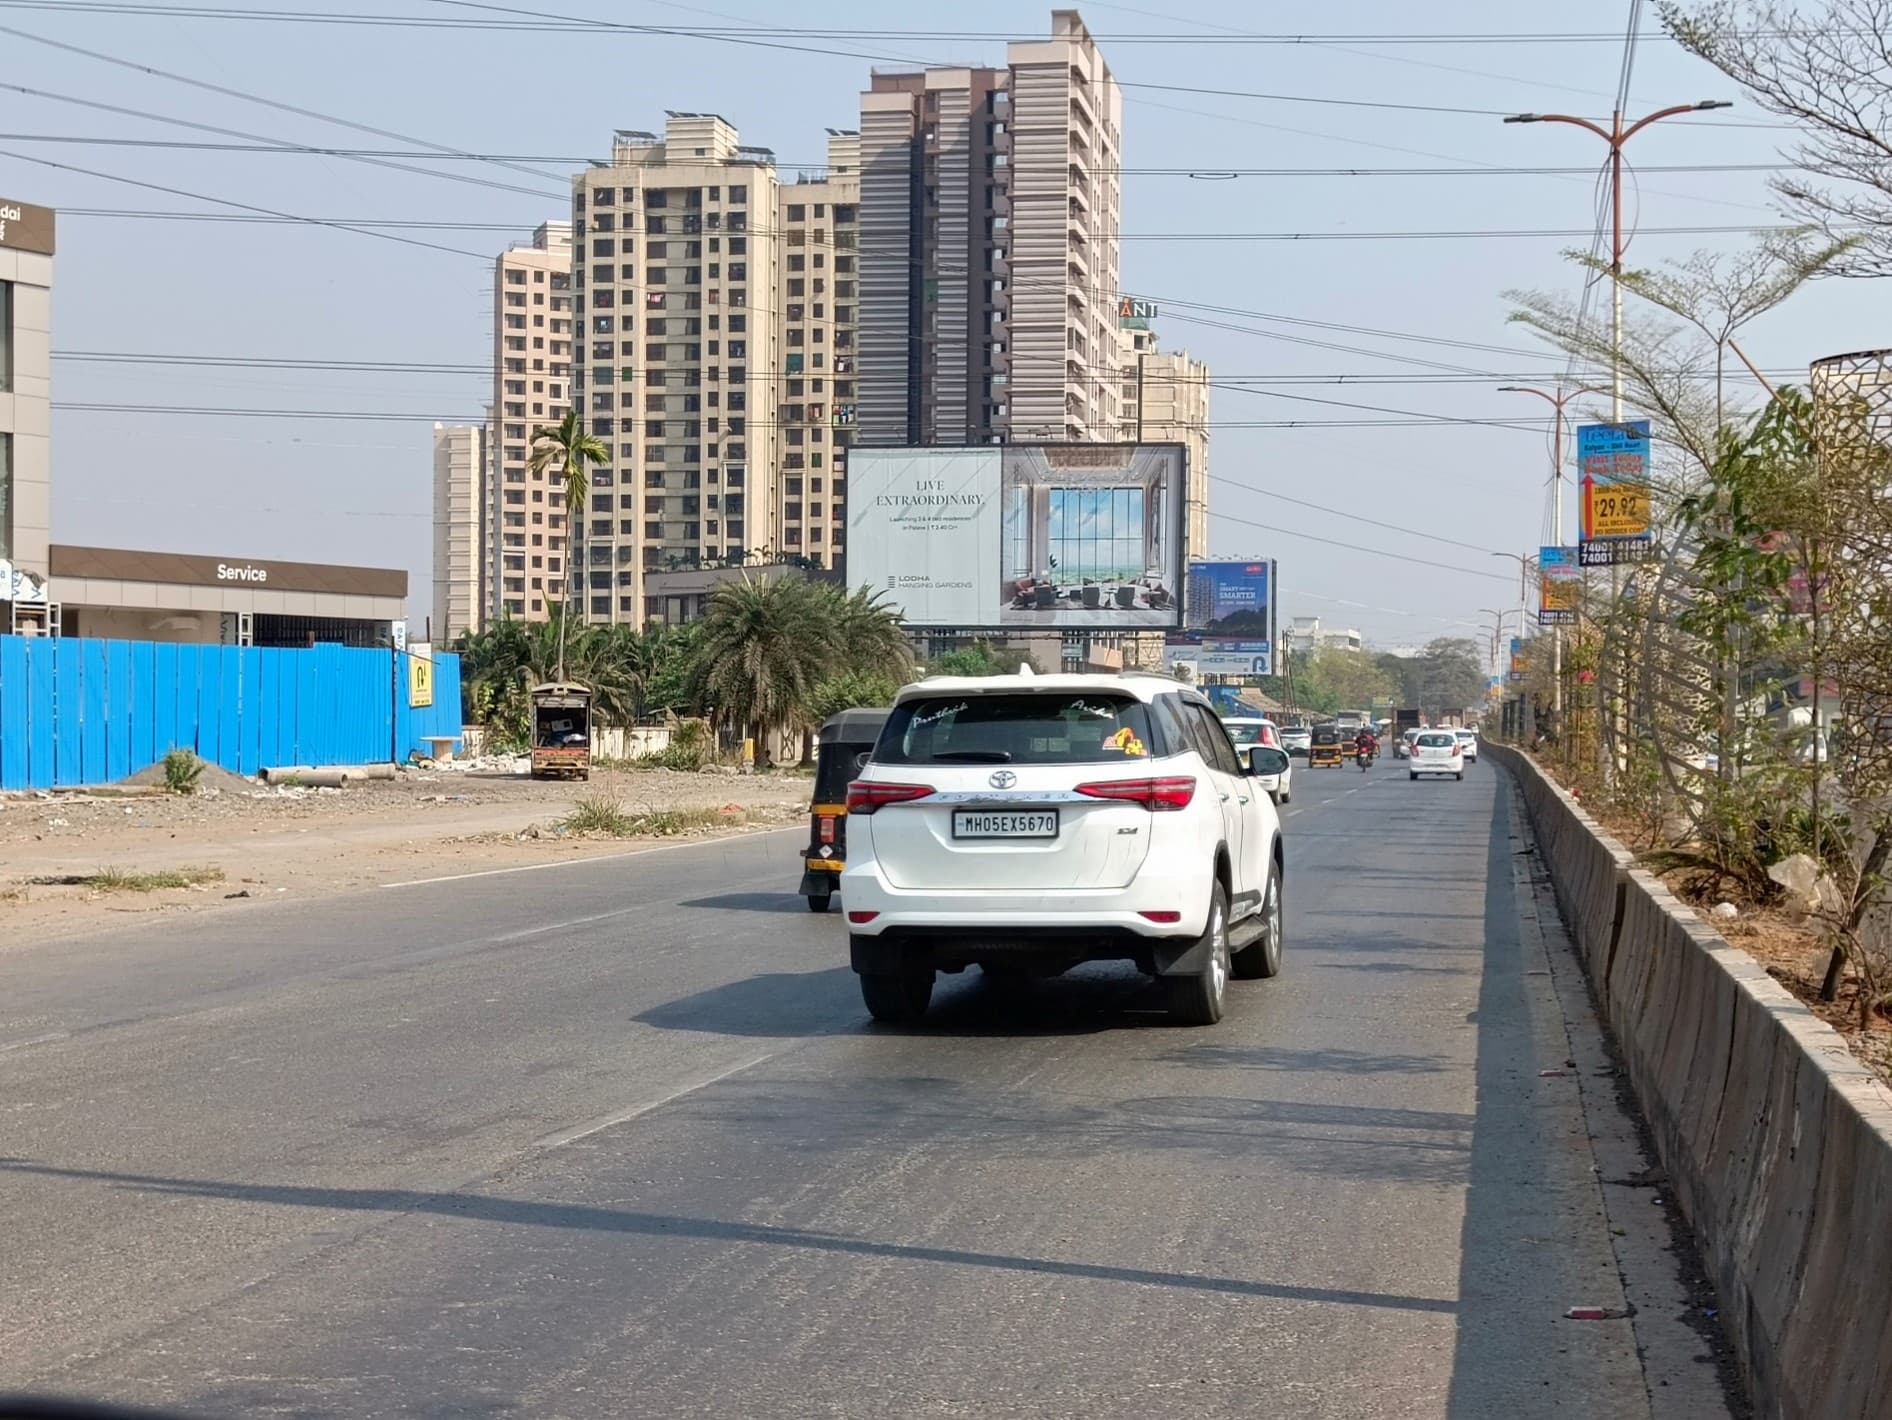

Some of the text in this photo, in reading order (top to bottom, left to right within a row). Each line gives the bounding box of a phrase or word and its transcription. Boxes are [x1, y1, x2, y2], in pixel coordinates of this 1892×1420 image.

[916, 480, 945, 491] LIVE
[876, 494, 986, 506] EXTRAORDINARY.
[1582, 542, 1613, 552] 74001
[1581, 552, 1613, 563] 74001
[217, 564, 267, 581] Service
[1219, 591, 1256, 599] SMARTER
[965, 816, 1054, 832] MH05EX5670
